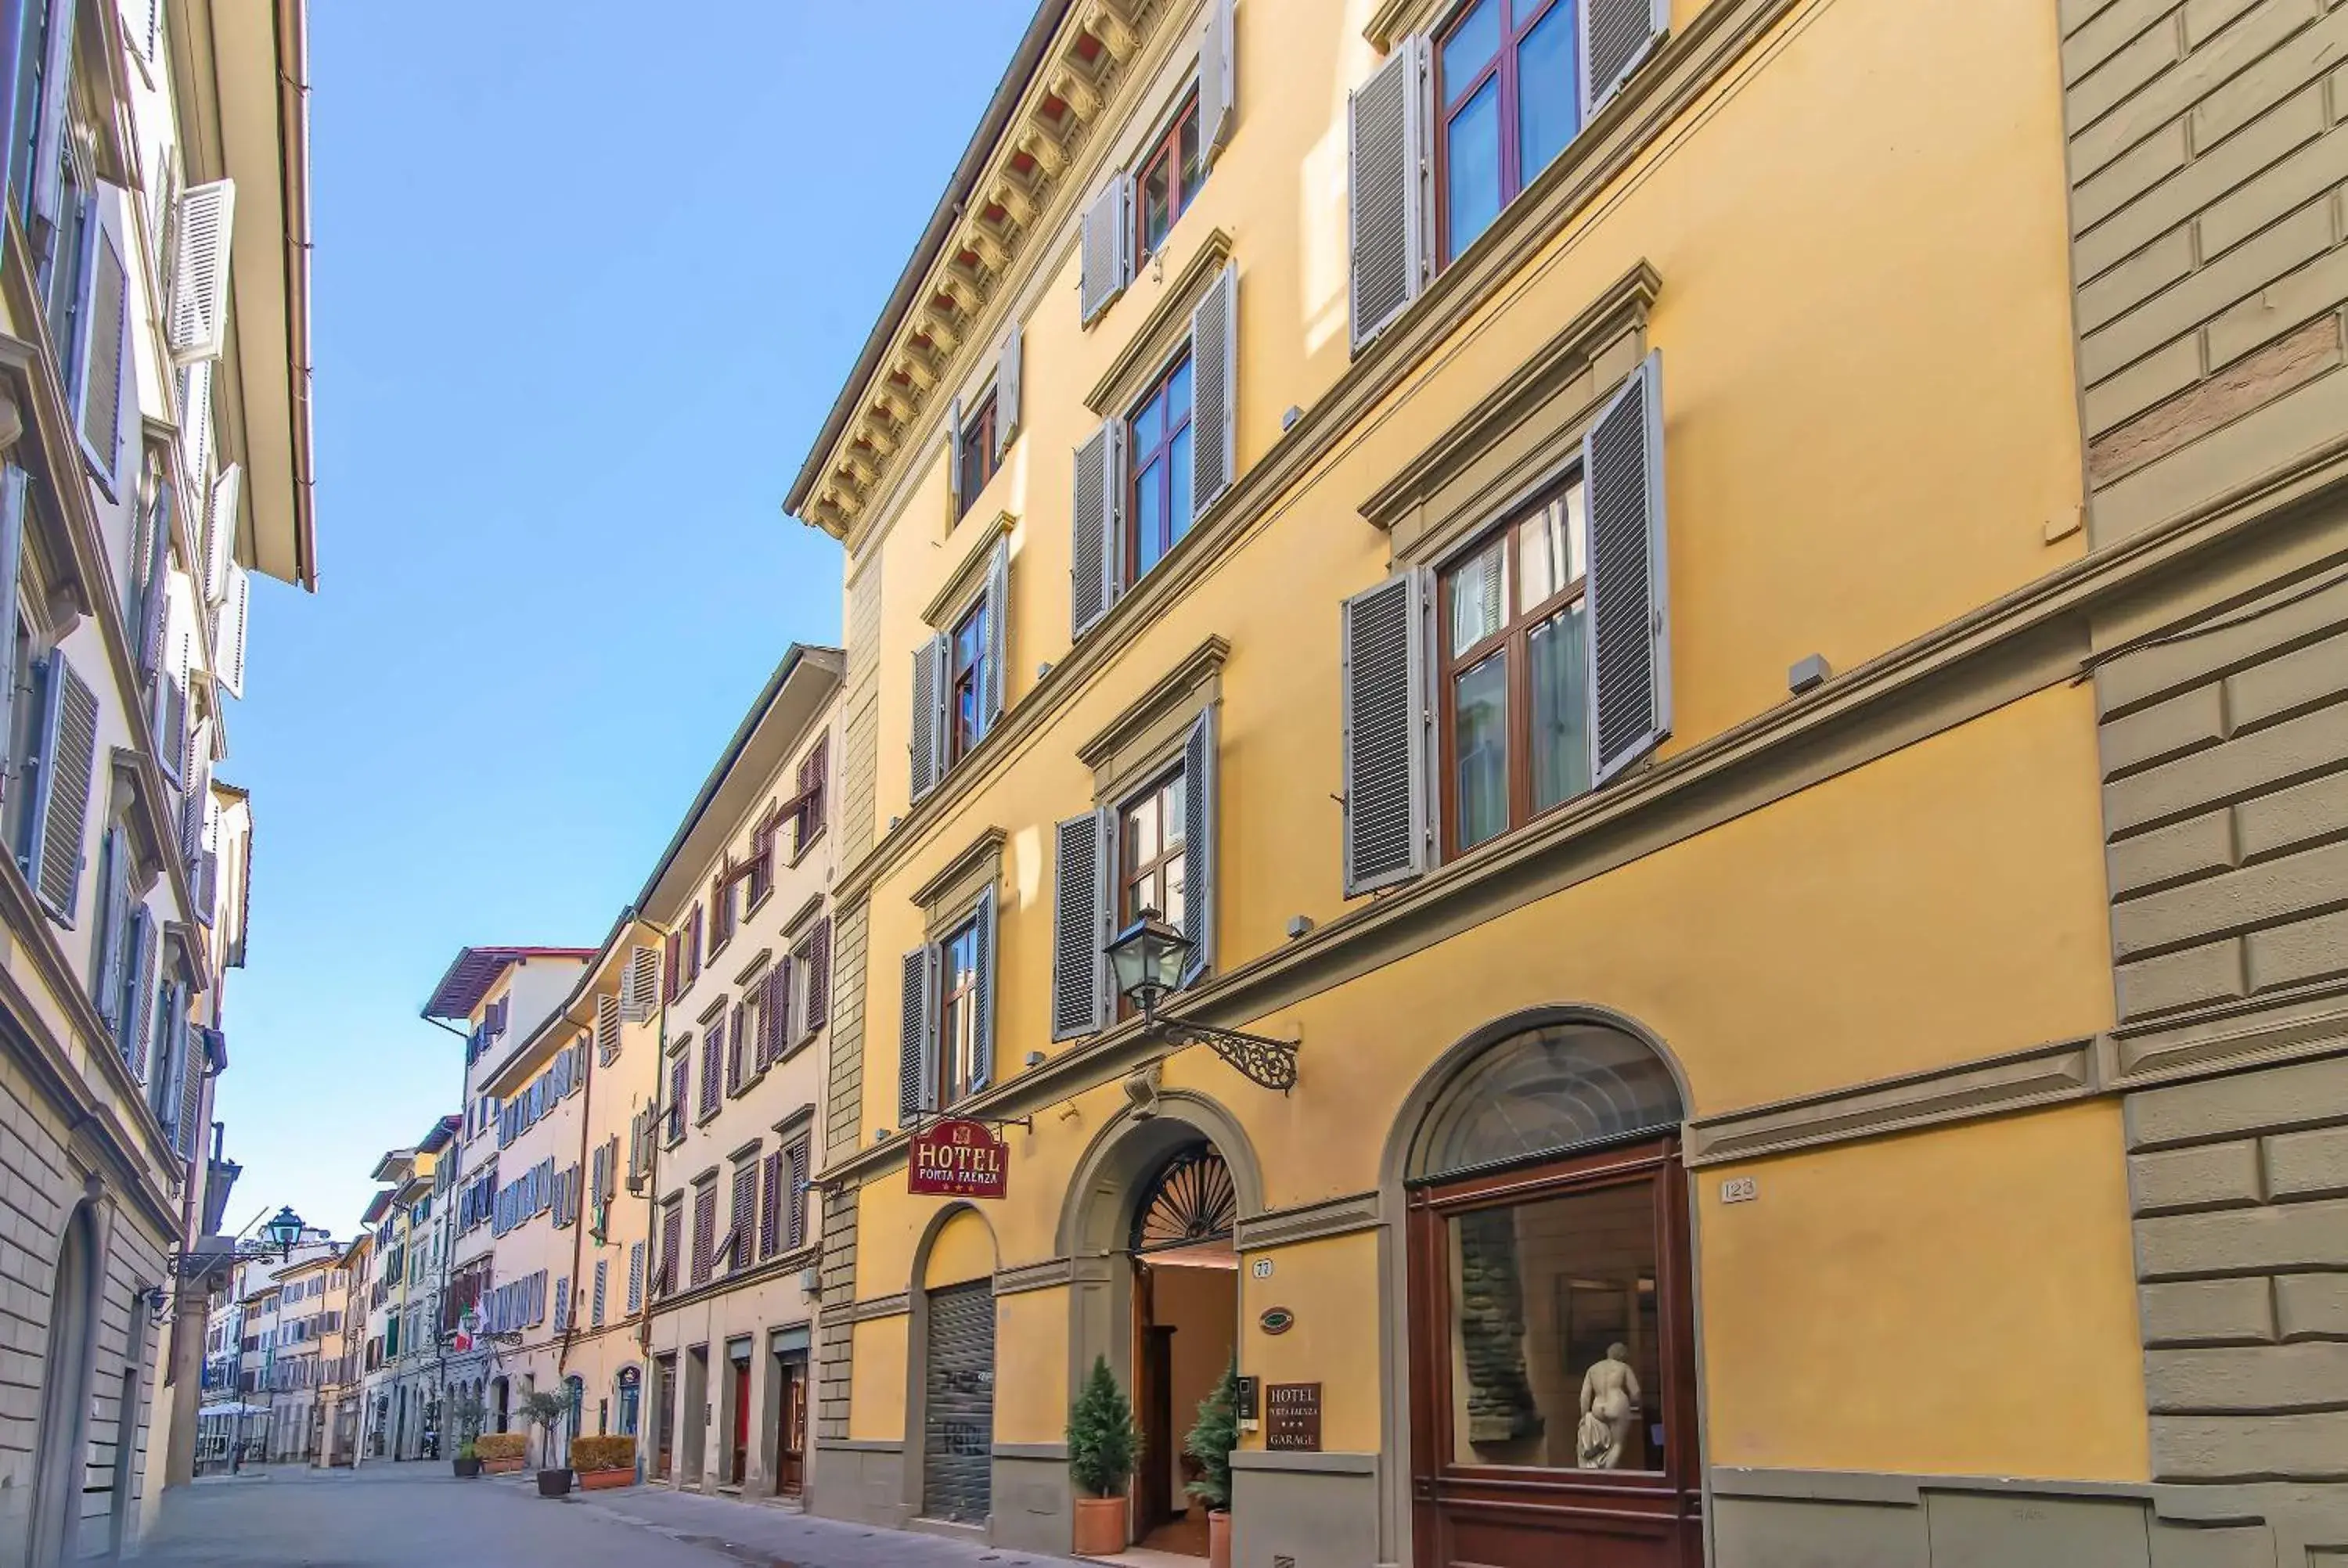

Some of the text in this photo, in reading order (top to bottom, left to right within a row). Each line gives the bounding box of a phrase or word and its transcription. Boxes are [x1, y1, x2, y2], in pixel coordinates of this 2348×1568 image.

[918, 1143, 999, 1172] HOTEL
[920, 1168, 998, 1184] PORTA FAENZA
[1271, 1389, 1316, 1403] HOTEL
[1270, 1434, 1316, 1446] GARAGE
